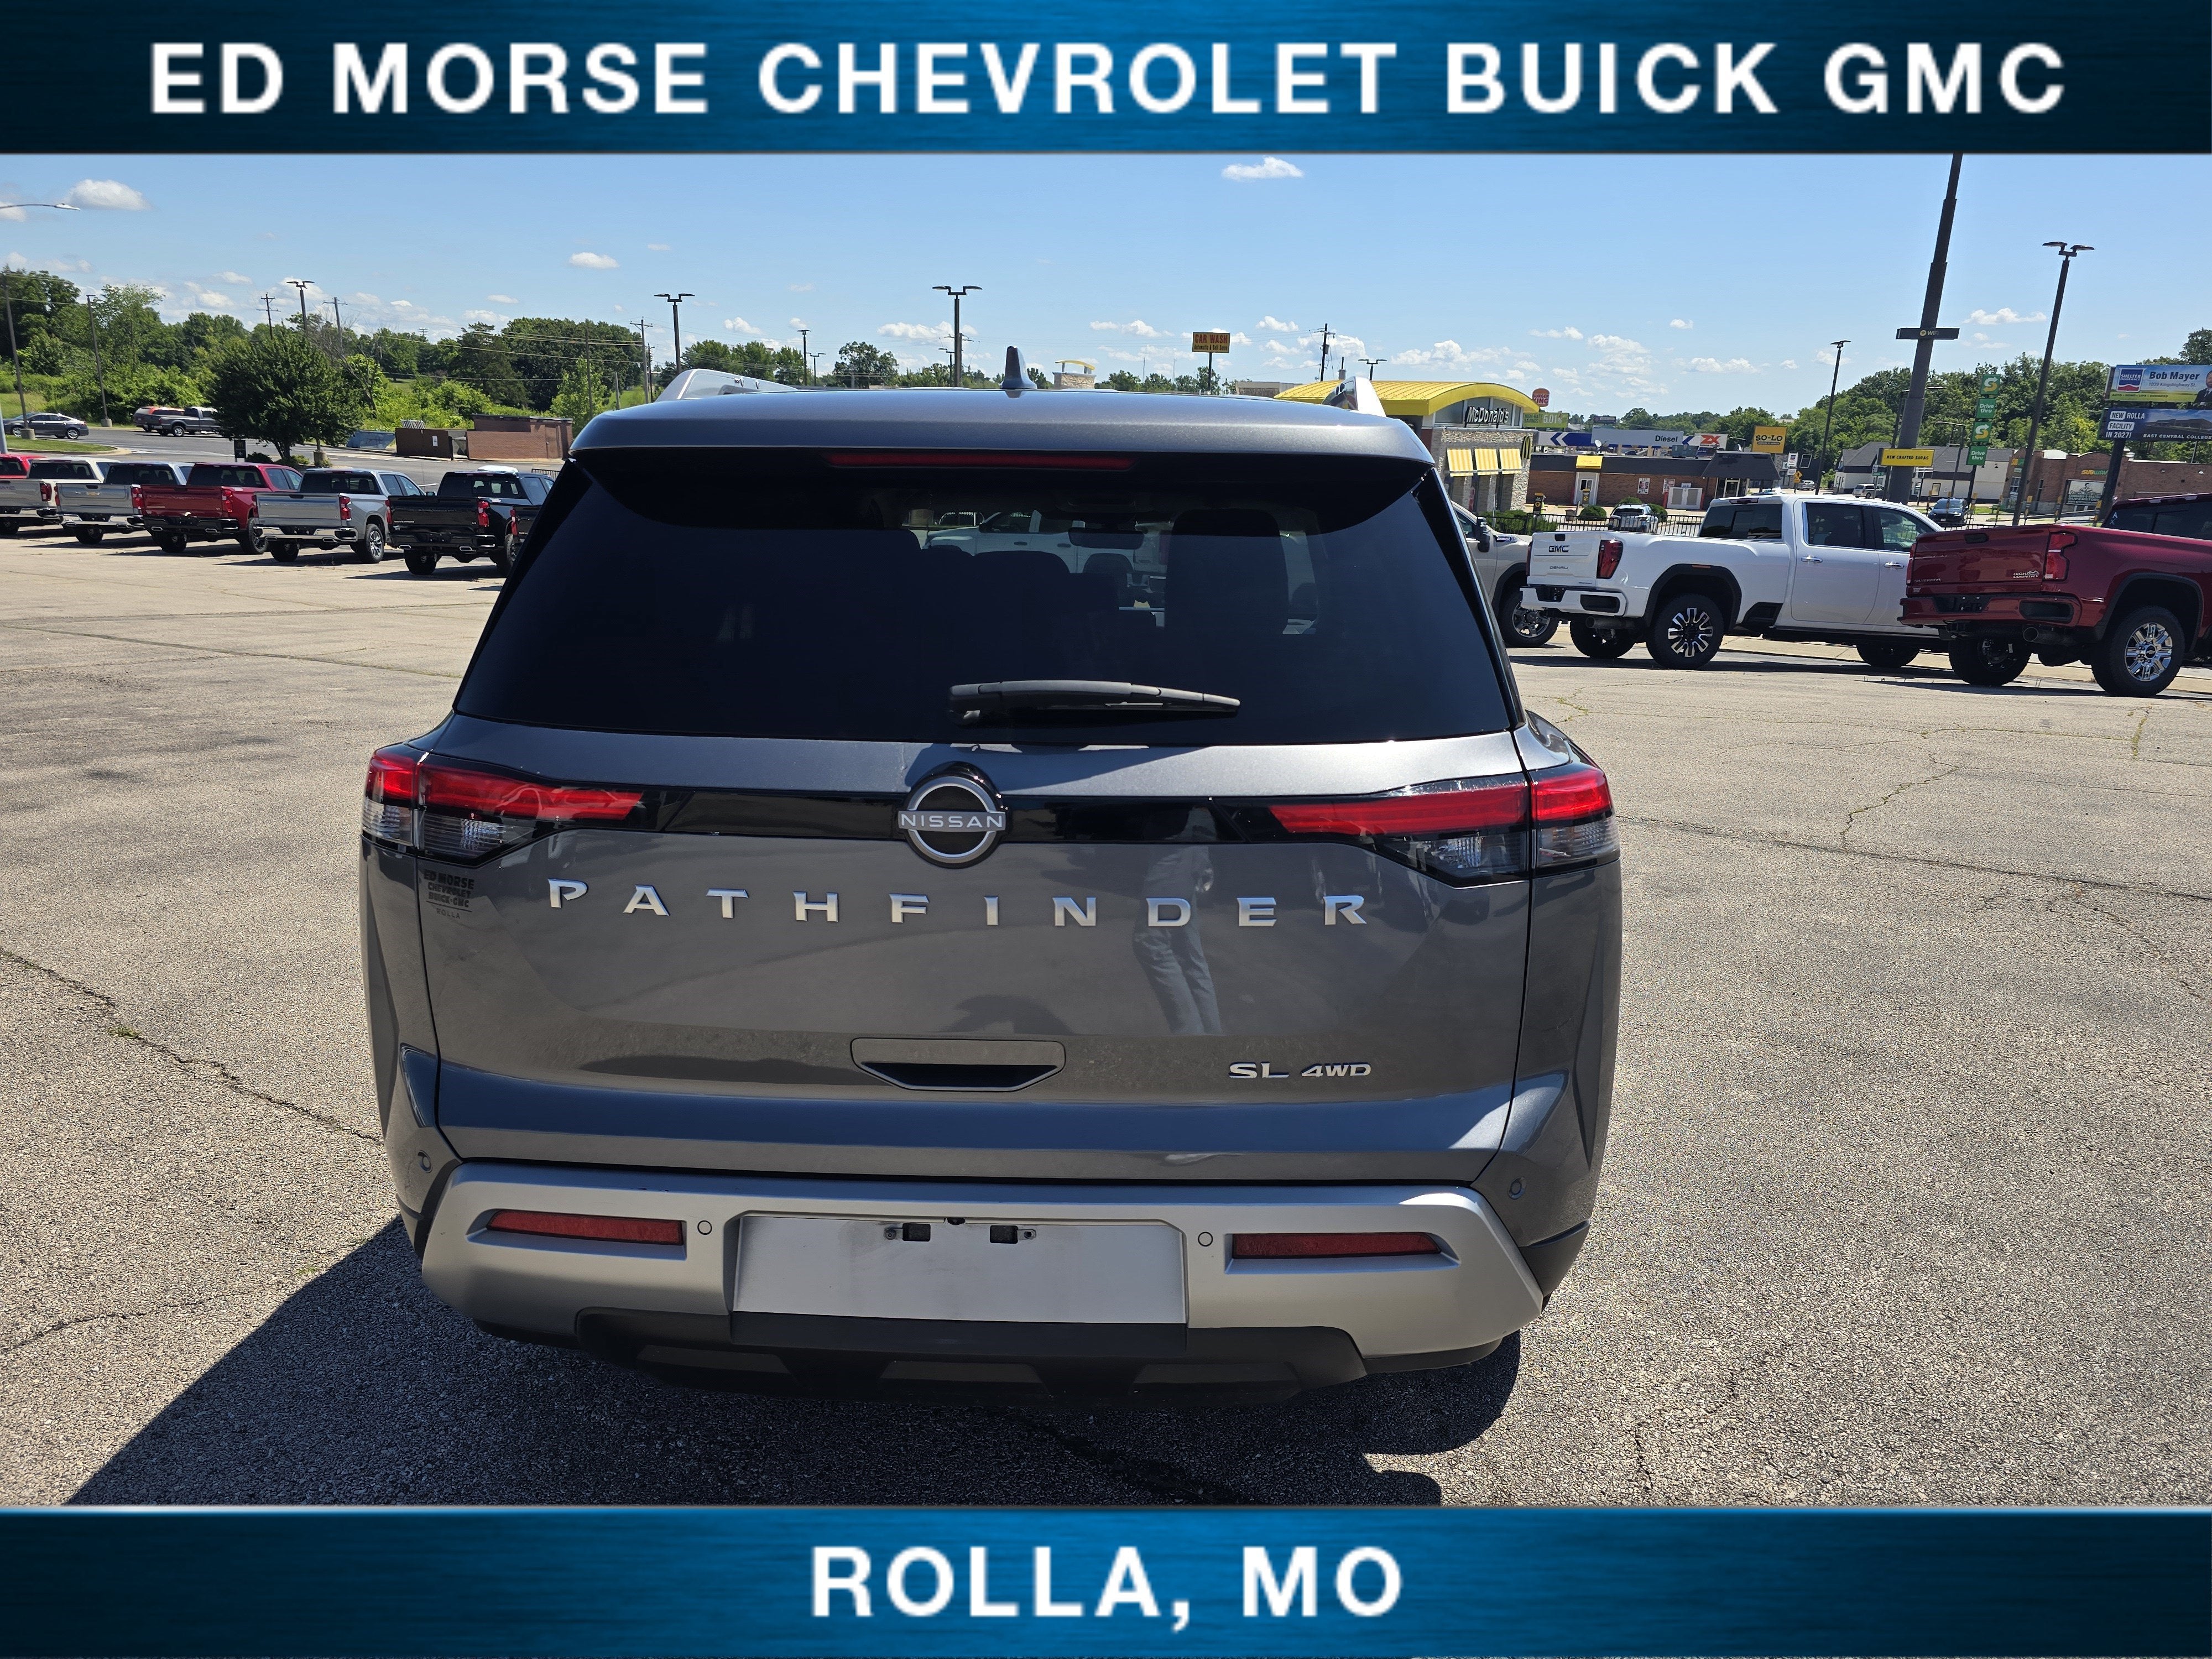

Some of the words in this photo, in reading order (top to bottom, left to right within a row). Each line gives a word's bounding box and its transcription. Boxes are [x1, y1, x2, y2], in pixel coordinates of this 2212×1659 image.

[1195, 334, 1207, 343] CAR
[1209, 335, 1228, 343] WASH
[2149, 371, 2168, 379] Bob
[2169, 372, 2200, 382] Mayer
[1465, 406, 1509, 424] McDonald's
[901, 813, 1003, 828] NISSAN
[424, 869, 436, 881] ED
[438, 873, 475, 890] MORSE
[428, 881, 471, 898] CHEVROLET
[547, 878, 1367, 927] PATHFINDER
[436, 907, 461, 919] ROLLA
[1229, 1062, 1290, 1078] SL
[1301, 1063, 1371, 1077] 4WD
